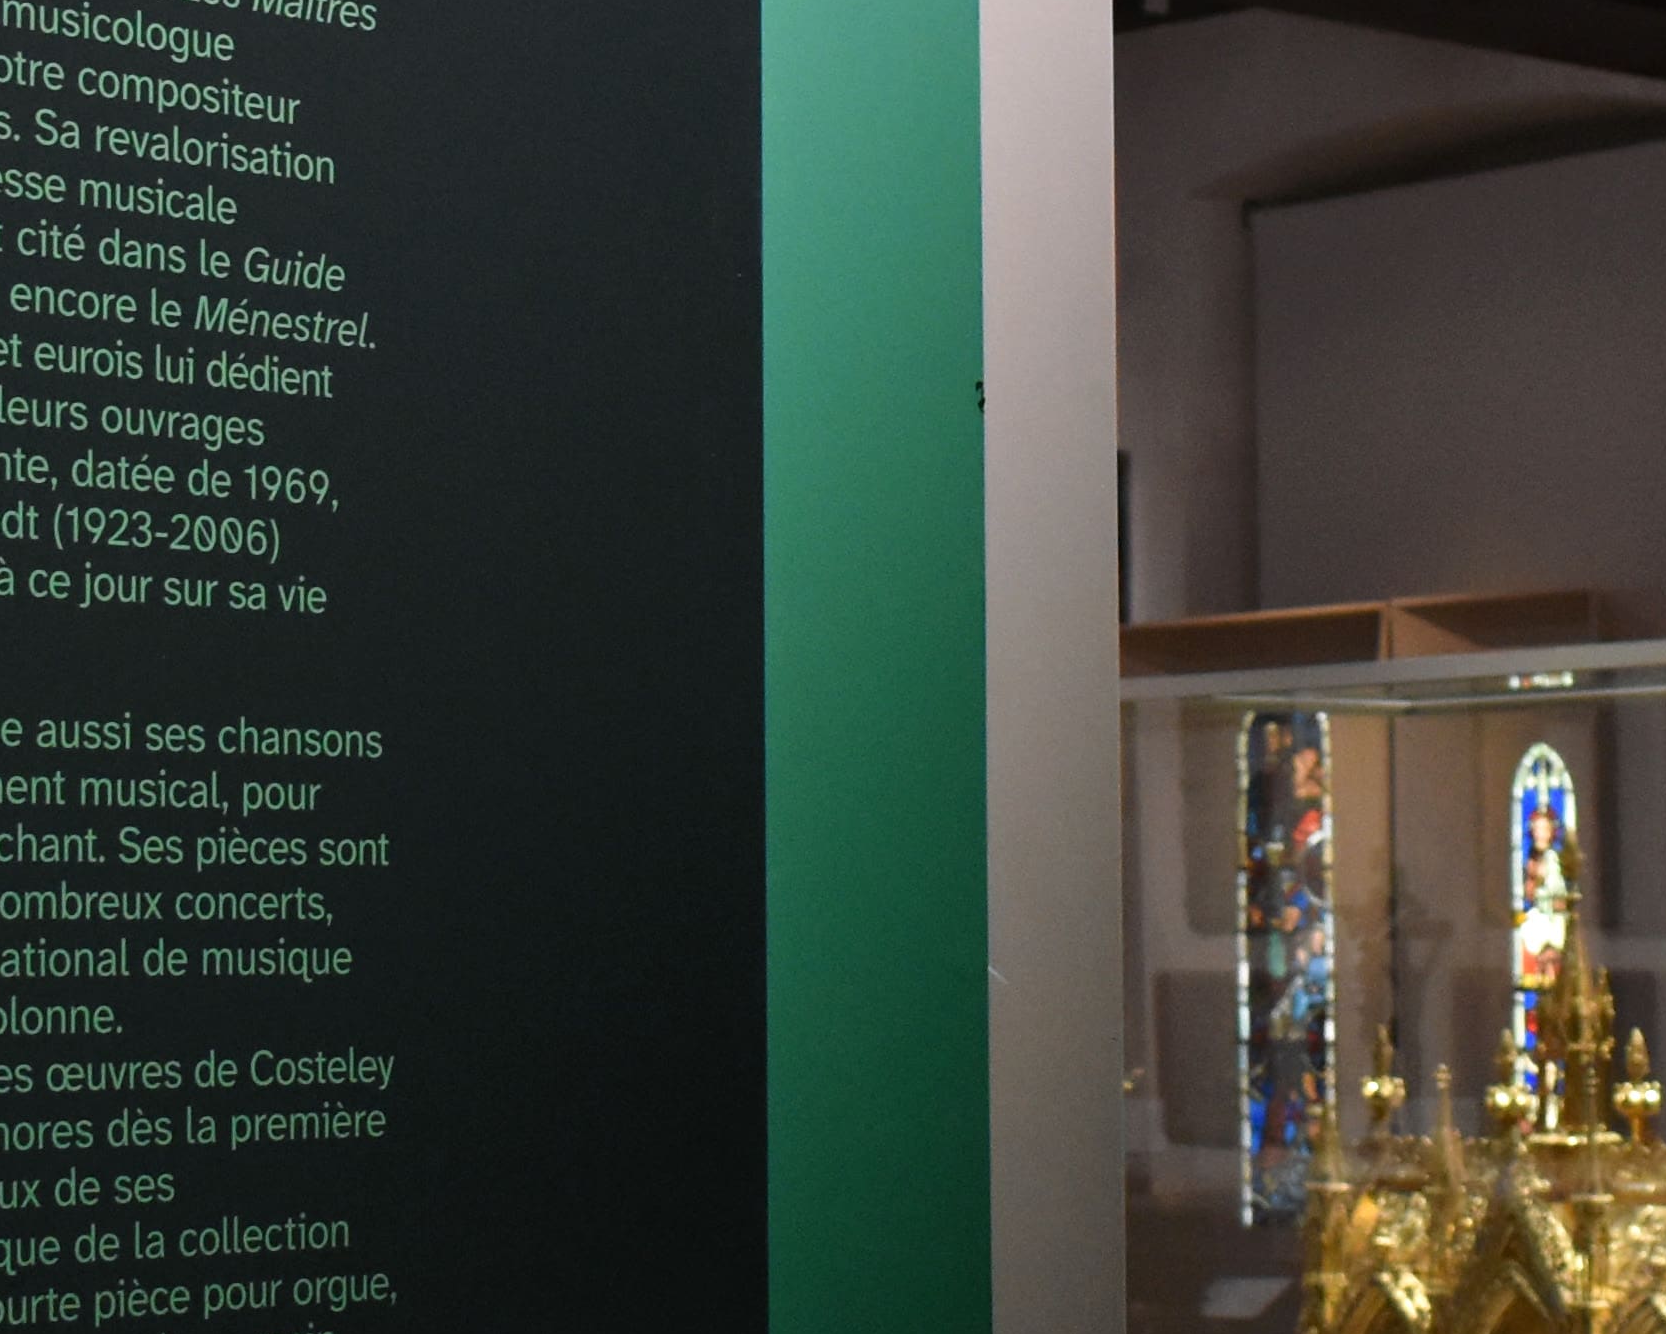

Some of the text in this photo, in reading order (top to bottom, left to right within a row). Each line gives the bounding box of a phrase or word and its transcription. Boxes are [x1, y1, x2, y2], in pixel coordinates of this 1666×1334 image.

[76, 66, 302, 126] compositeur
[33, 106, 82, 151] Sa
[94, 123, 336, 186] revalorisation
[78, 176, 239, 226] musicale
[99, 404, 266, 453] ouvrages
[52, 502, 281, 566] (1923-2006)
[79, 768, 230, 816] musical,
[241, 781, 323, 819] pour
[106, 1106, 174, 1149] dès
[185, 1104, 218, 1145] la
[230, 1099, 388, 1152] première
